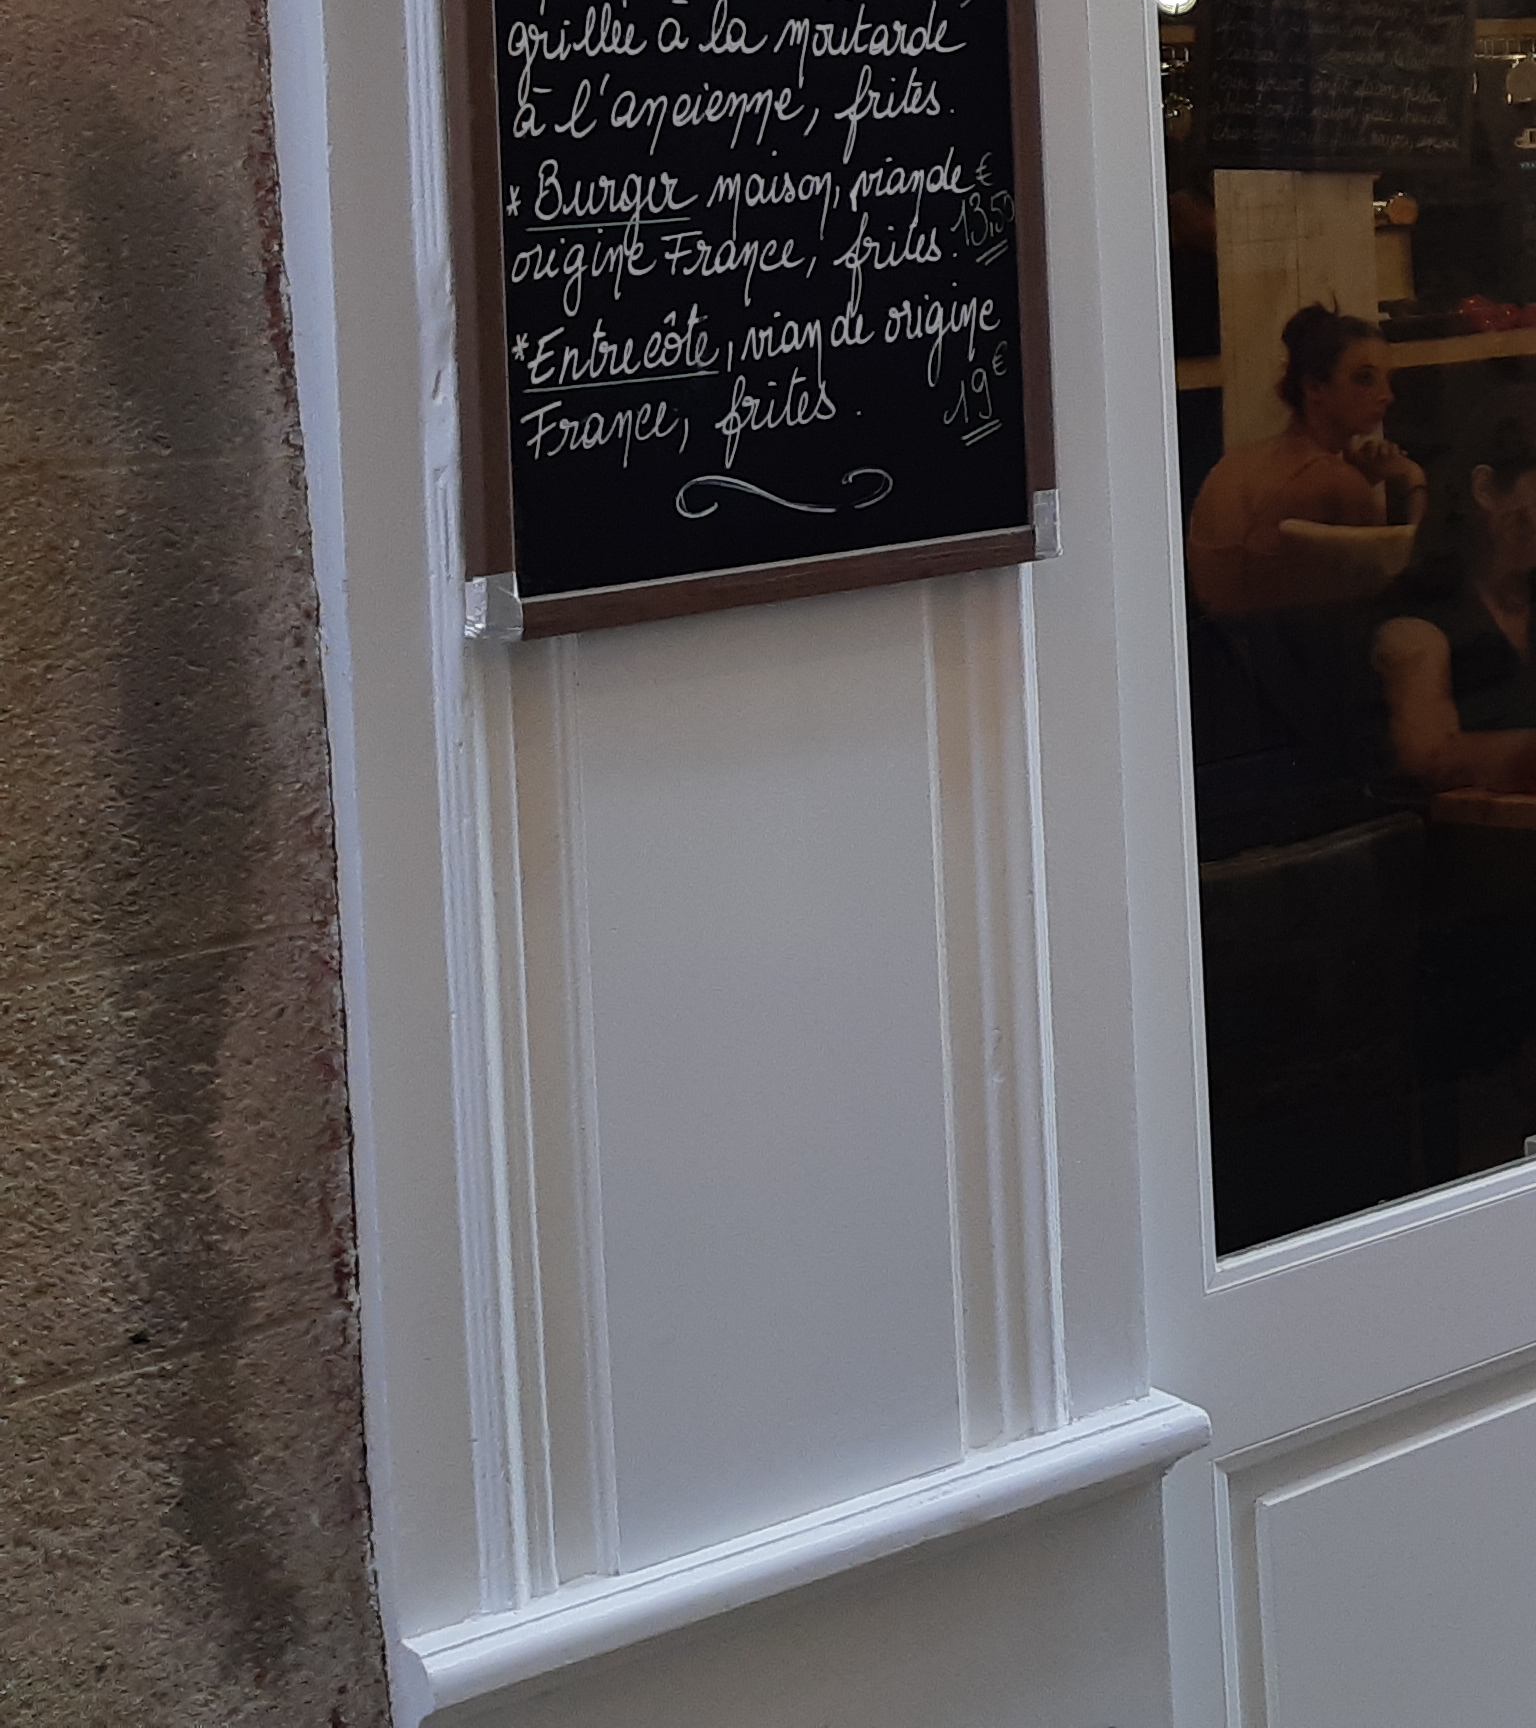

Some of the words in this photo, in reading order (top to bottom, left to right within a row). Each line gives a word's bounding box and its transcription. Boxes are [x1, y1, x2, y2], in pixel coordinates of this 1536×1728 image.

[533, 156, 698, 241] Burger
[510, 235, 656, 316] origine
[883, 283, 1001, 389] origine
